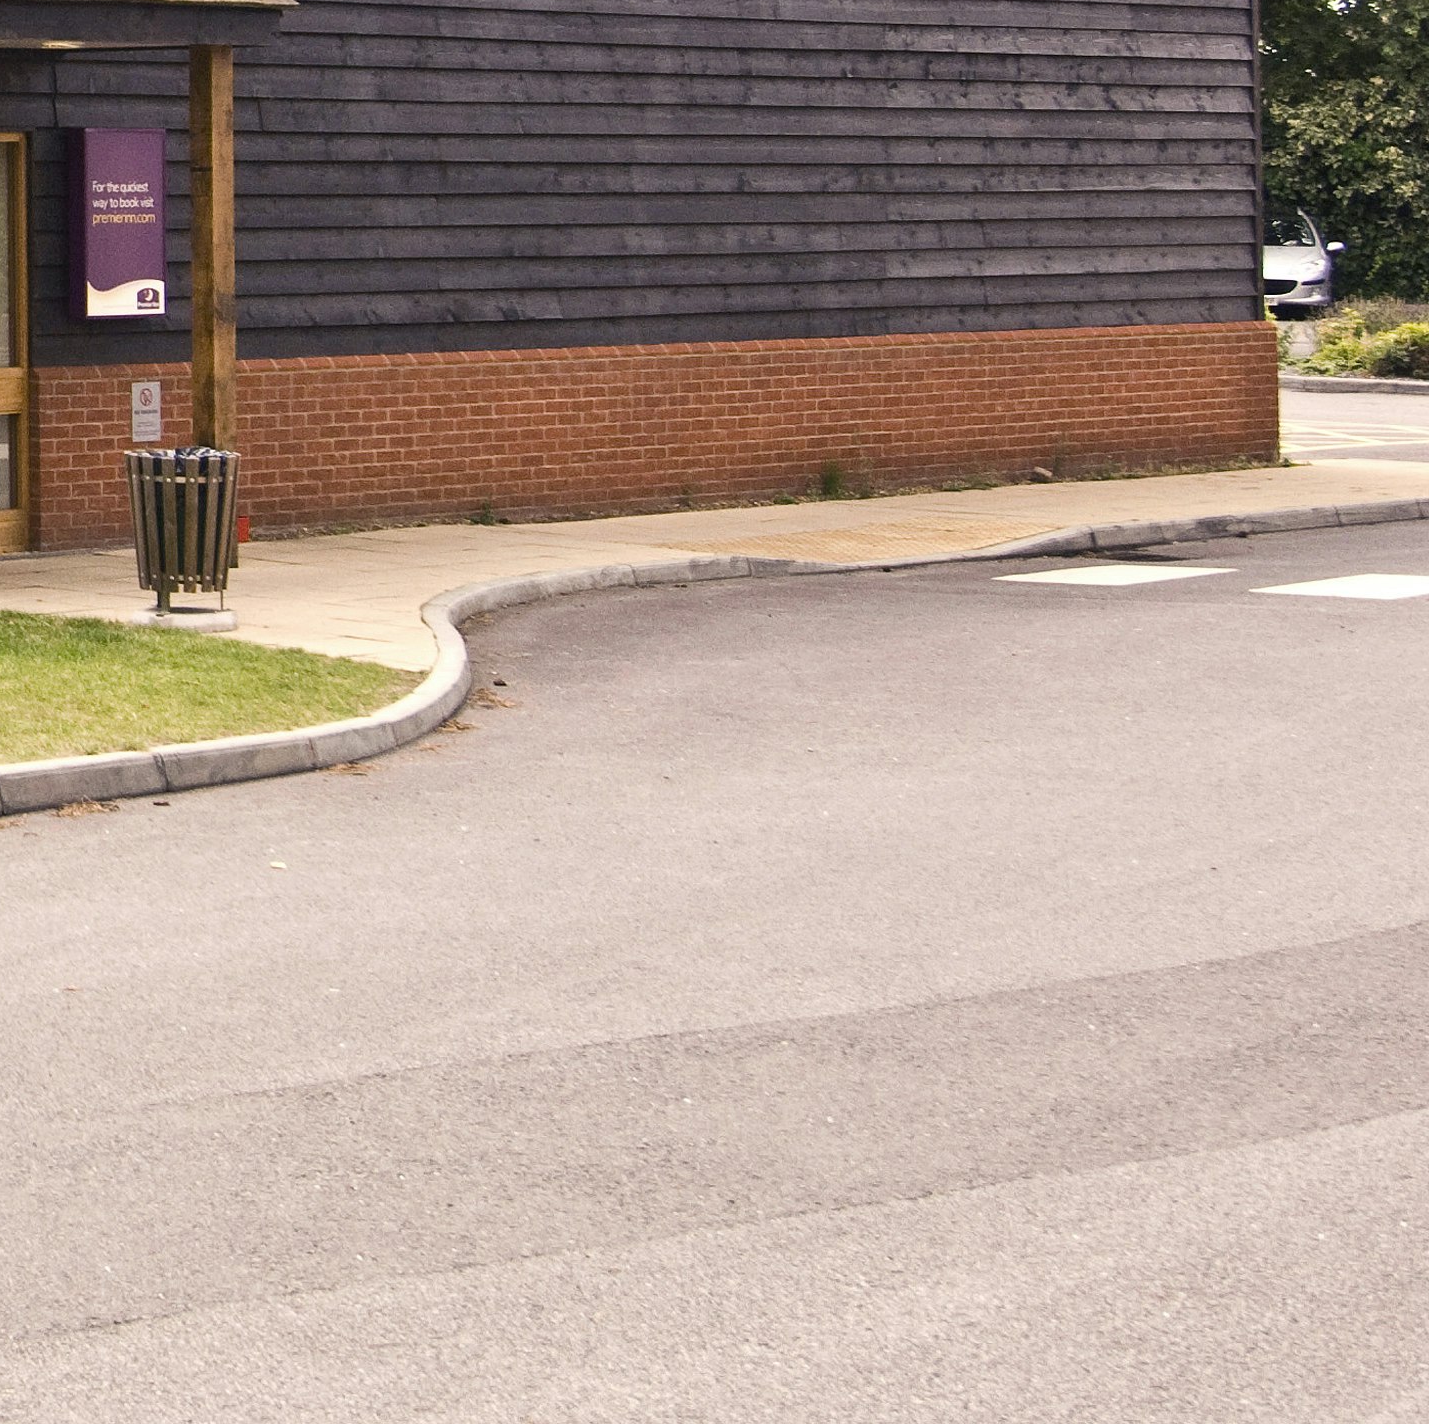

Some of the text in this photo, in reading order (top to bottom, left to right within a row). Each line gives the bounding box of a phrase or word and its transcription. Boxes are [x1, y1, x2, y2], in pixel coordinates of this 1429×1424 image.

[92, 180, 149, 195] For the quickest
[92, 199, 108, 210] way
[109, 198, 118, 208] to
[120, 197, 139, 208] book
